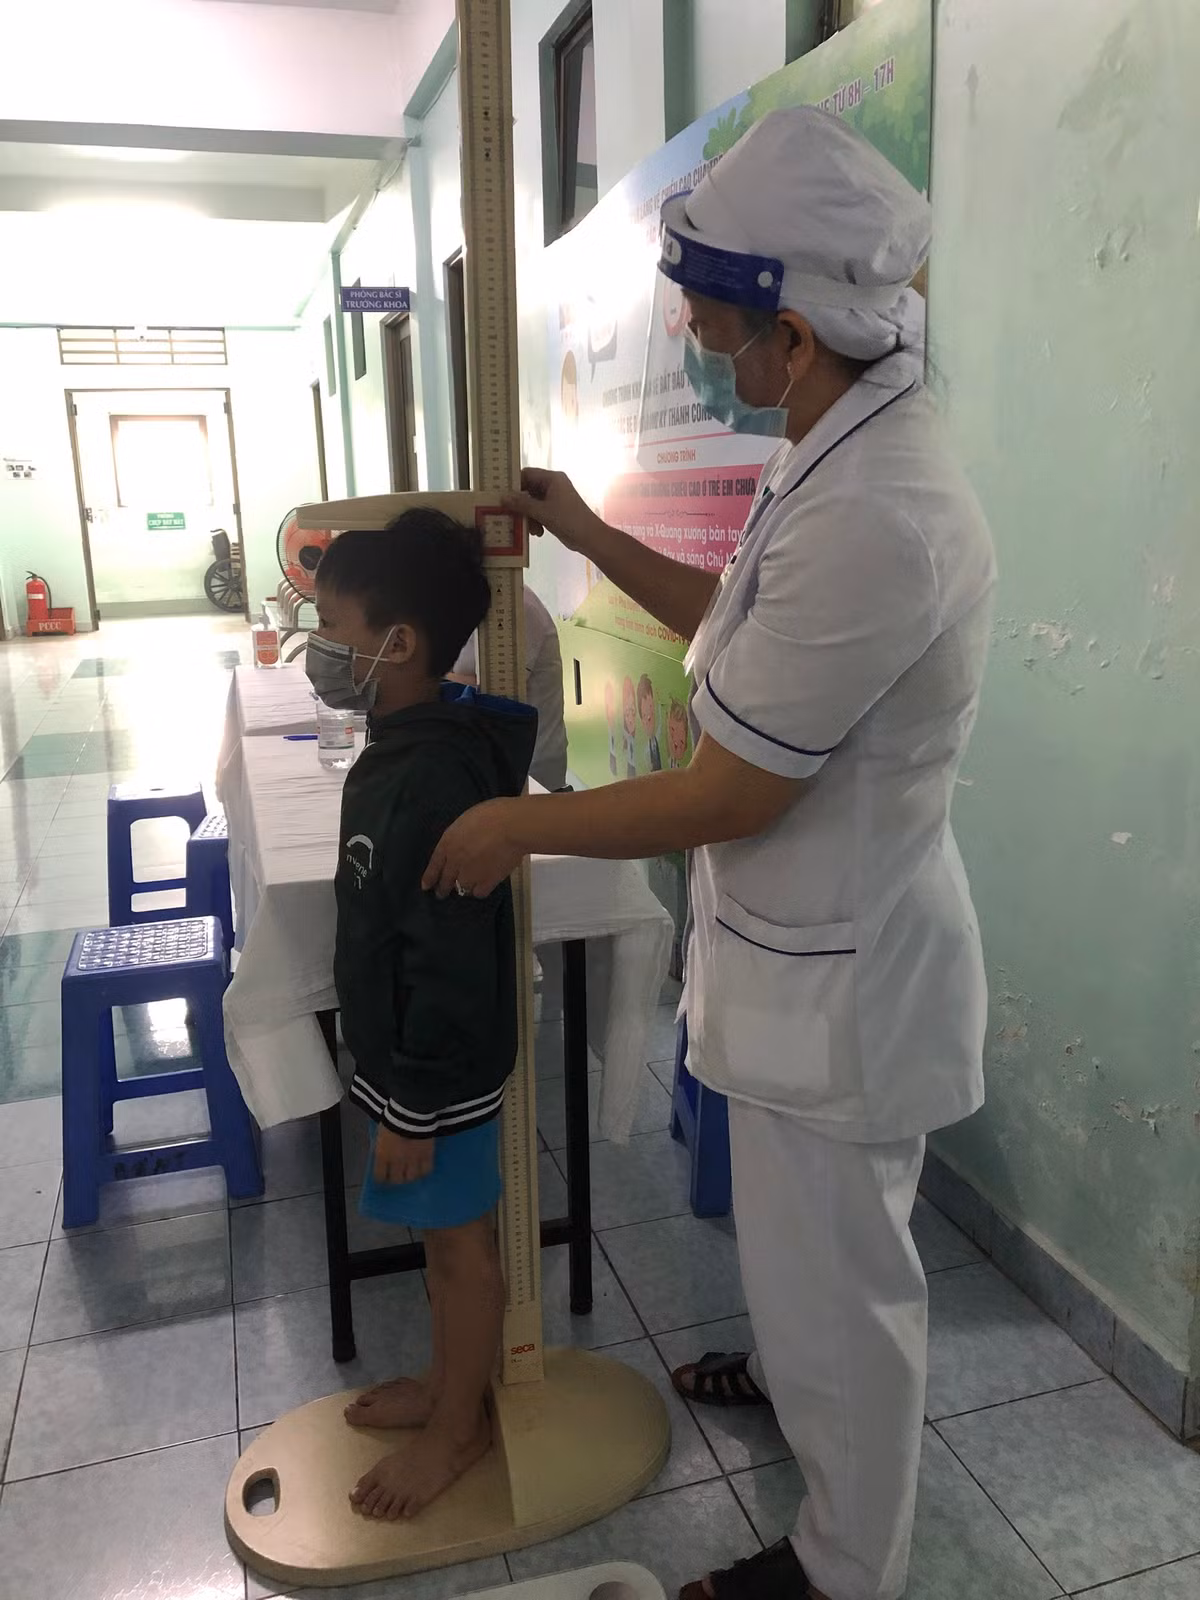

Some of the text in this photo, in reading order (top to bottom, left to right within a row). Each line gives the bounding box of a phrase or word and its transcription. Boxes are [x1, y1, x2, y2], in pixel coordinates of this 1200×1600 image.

[848, 78, 862, 108] 8H
[873, 57, 895, 93] 17H
[350, 289, 378, 298] PHÒNG
[379, 289, 394, 298] BÁC
[383, 300, 409, 309] KHOA
[721, 479, 734, 497] EM
[708, 524, 726, 542] bàn
[686, 548, 705, 569] sáng
[706, 548, 724, 568] Chủ
[510, 1343, 536, 1355] seca
